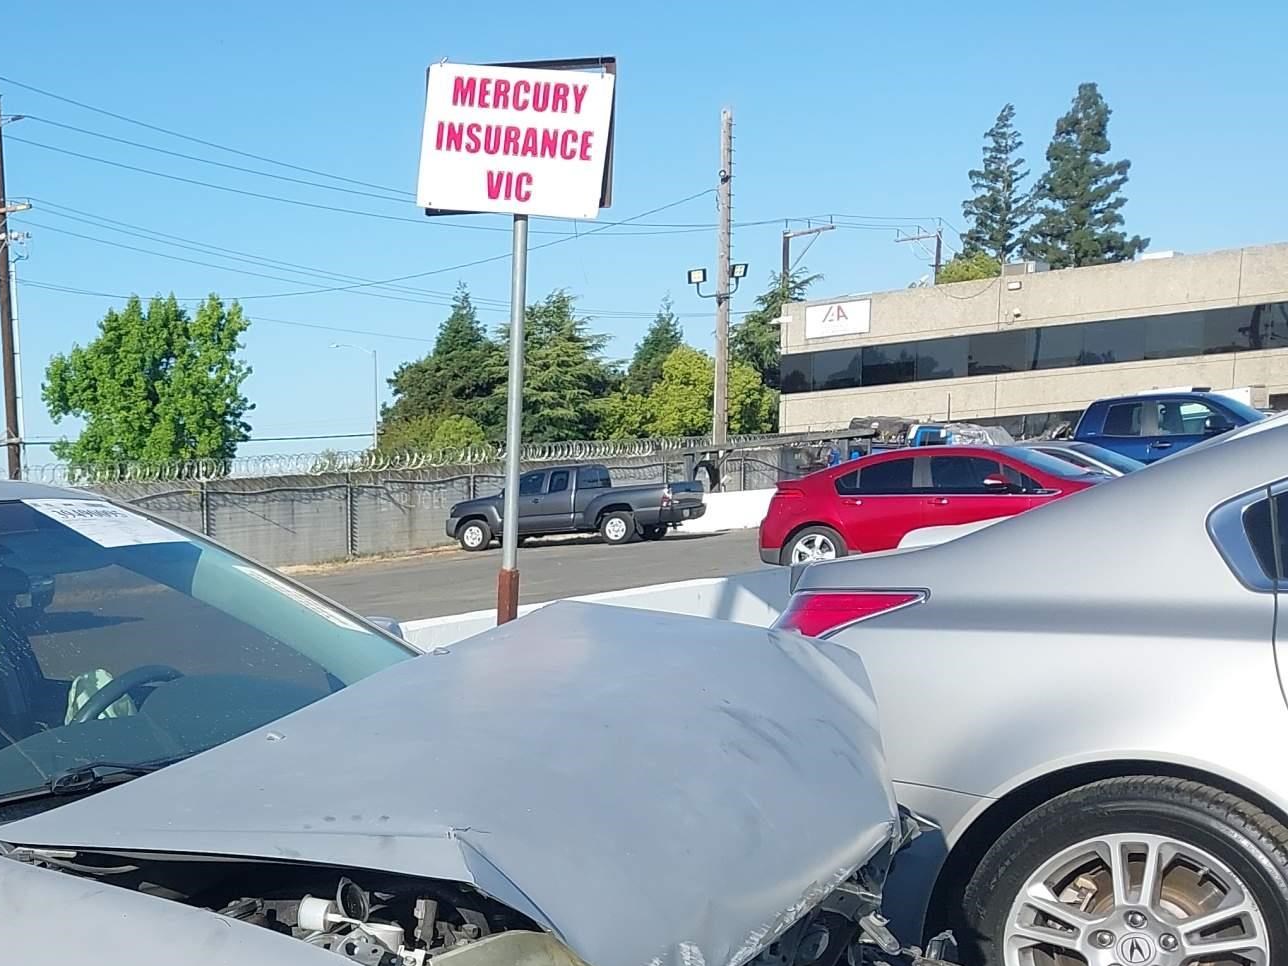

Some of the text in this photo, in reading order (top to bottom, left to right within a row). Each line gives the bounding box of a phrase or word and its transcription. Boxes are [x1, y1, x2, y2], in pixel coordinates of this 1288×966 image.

[451, 76, 589, 114] MERCURY
[435, 120, 595, 161] INSURANCE
[486, 169, 534, 202] VIC
